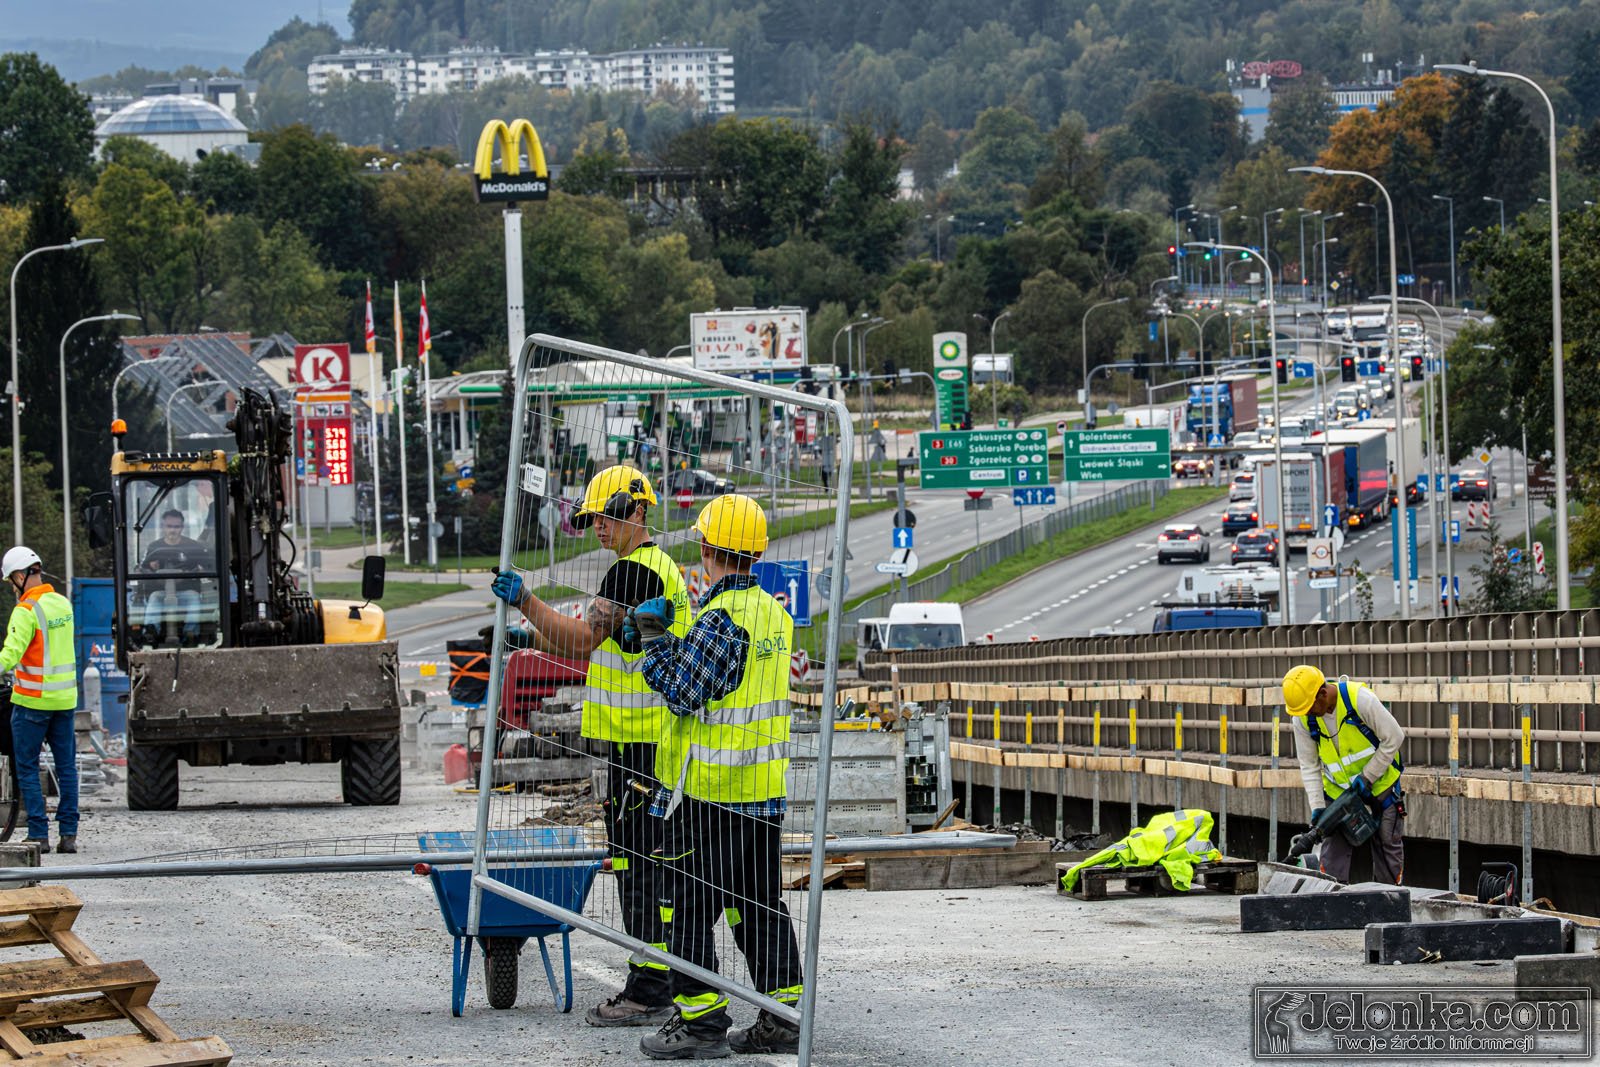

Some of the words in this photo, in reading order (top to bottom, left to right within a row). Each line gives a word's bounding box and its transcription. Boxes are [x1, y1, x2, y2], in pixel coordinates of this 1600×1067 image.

[481, 182, 547, 194] McDonald's
[312, 356, 336, 384] K
[969, 432, 1013, 443] Jakuszyce
[1079, 432, 1132, 441] Bolesławiec
[969, 444, 1012, 453] Szklarska
[1014, 443, 1047, 453] Poręba
[945, 457, 954, 465] 30
[969, 456, 1012, 466] Zgorzelec
[1080, 459, 1114, 468] Lwówek
[1117, 458, 1144, 469] Śląski
[1080, 471, 1103, 480] Wien
